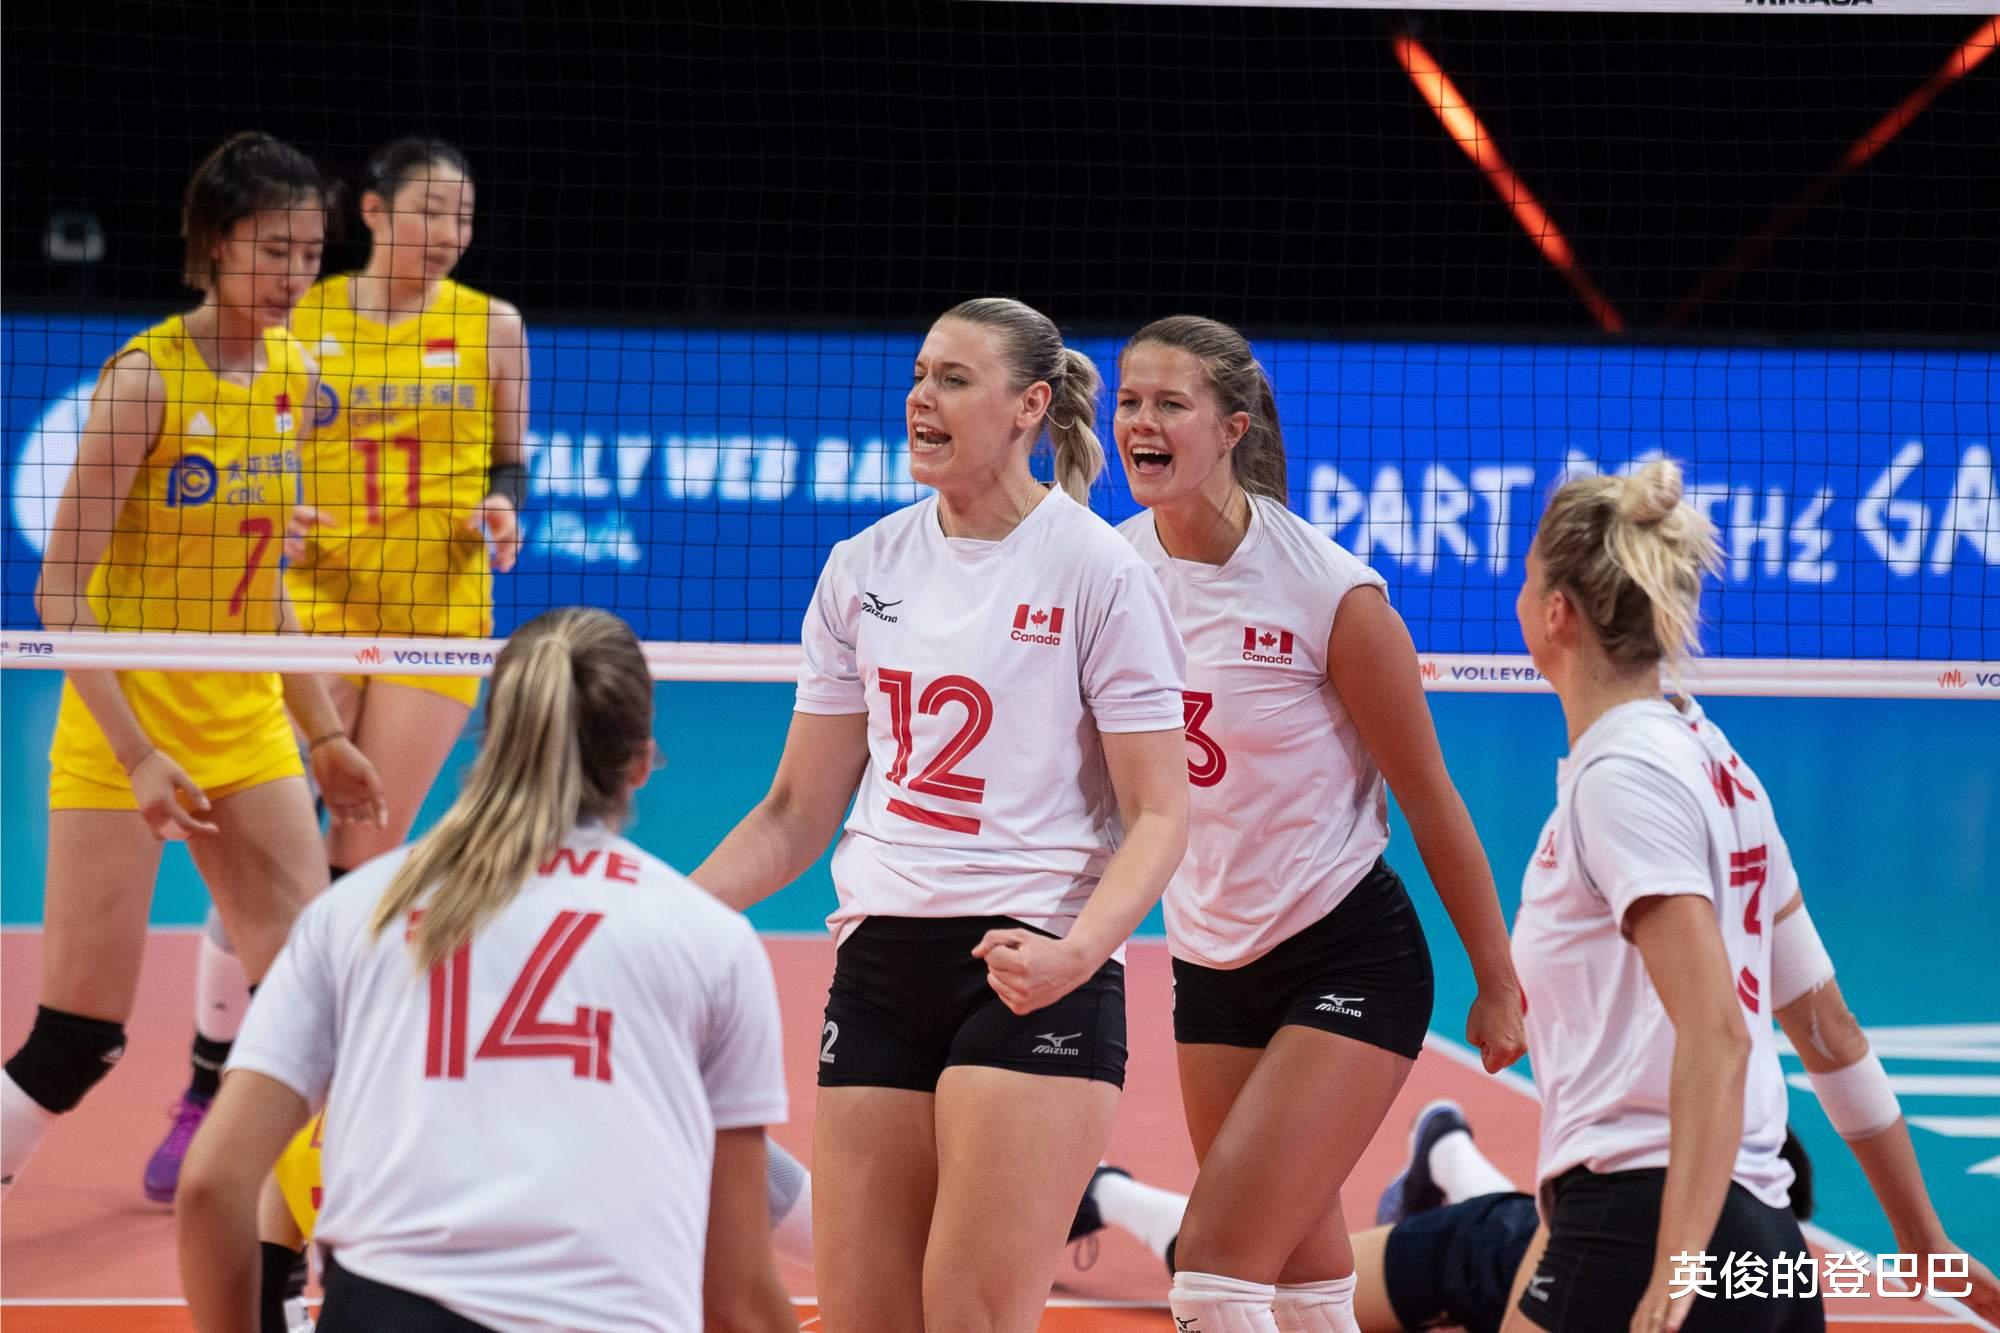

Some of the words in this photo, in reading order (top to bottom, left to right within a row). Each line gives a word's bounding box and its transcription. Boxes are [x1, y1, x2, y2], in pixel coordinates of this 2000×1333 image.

[1310, 463, 1536, 575] PART
[228, 517, 273, 617] 7
[394, 651, 493, 665] VOLLEYBA
[1010, 629, 1061, 646] Canada
[1242, 651, 1292, 665] Canada
[878, 667, 993, 803] 12
[538, 848, 641, 886] WE
[404, 909, 613, 1083] 14
